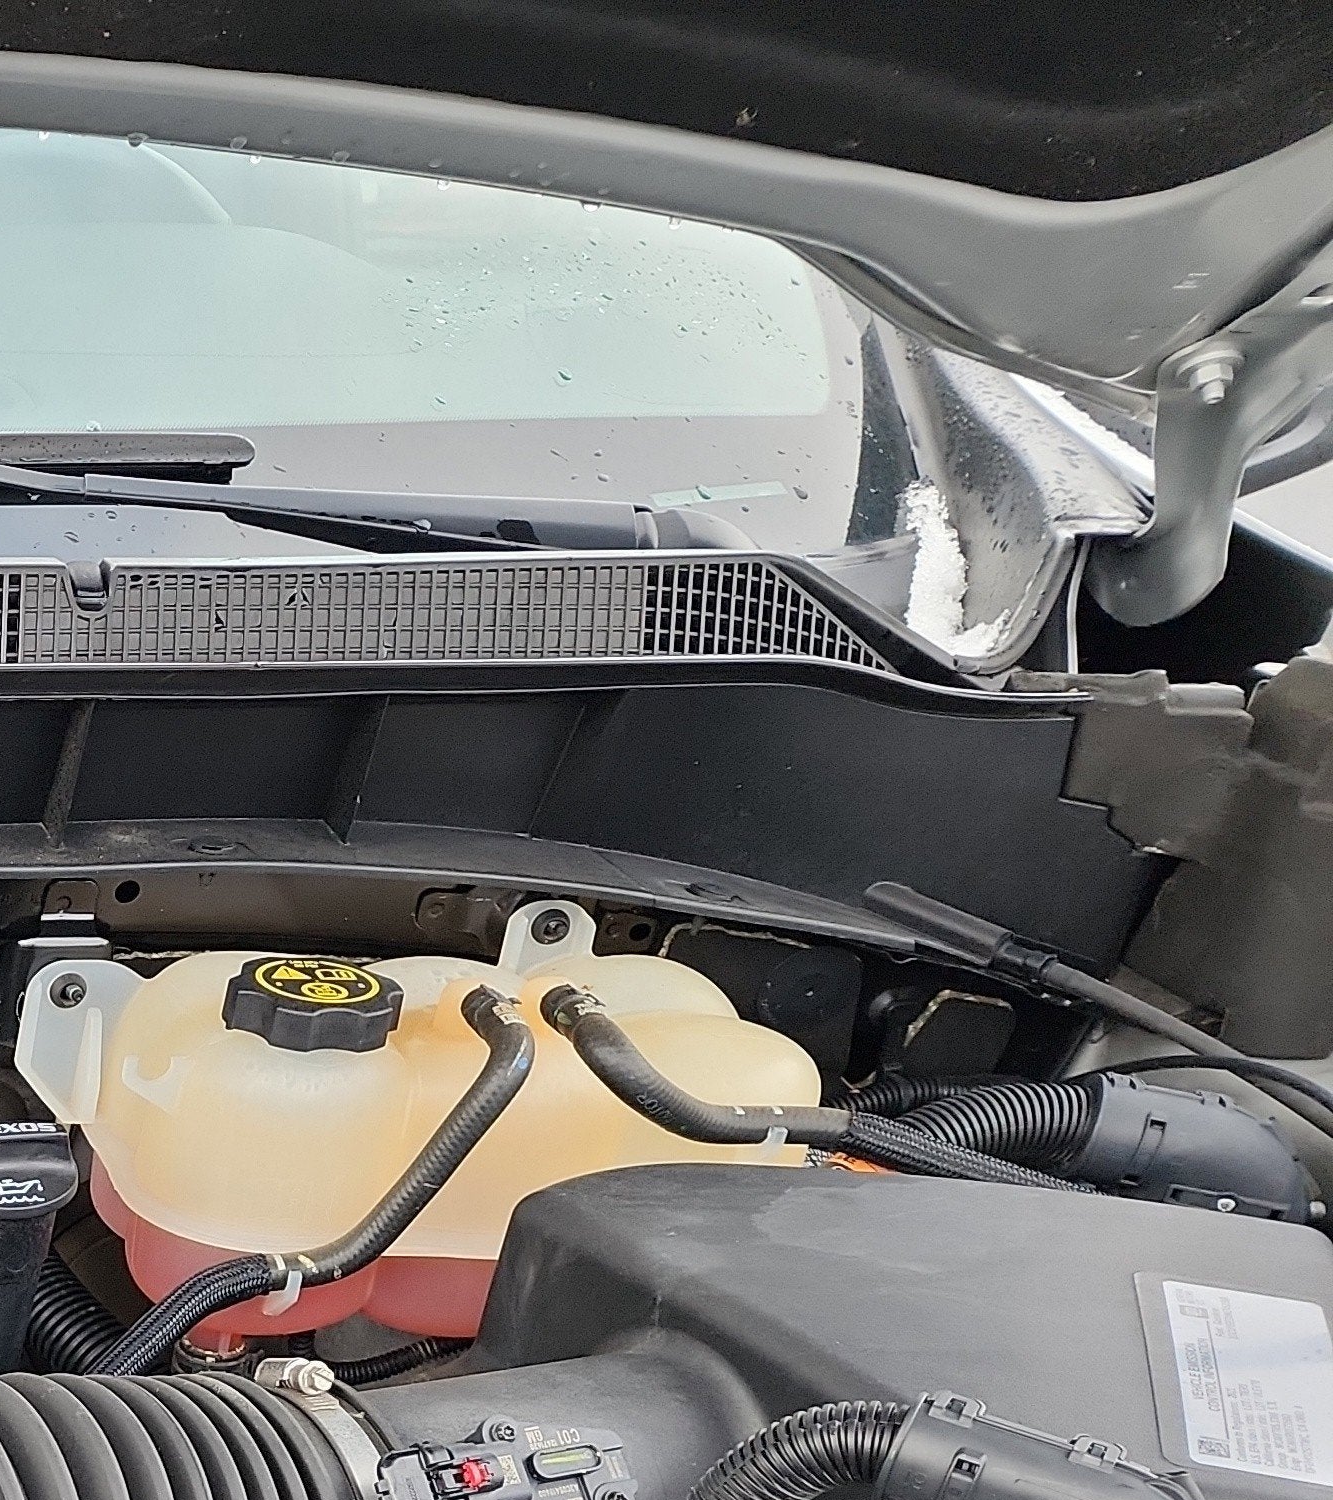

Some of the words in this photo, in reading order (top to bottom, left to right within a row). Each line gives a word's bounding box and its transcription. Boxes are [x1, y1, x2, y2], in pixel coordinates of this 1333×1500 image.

[1184, 1342, 1200, 1371] EMISSION
[1197, 1338, 1215, 1378] INFORMATION
[1189, 1371, 1204, 1400] VEHICLE
[1205, 1379, 1220, 1412] CONTROL
[525, 1430, 544, 1444] GM
